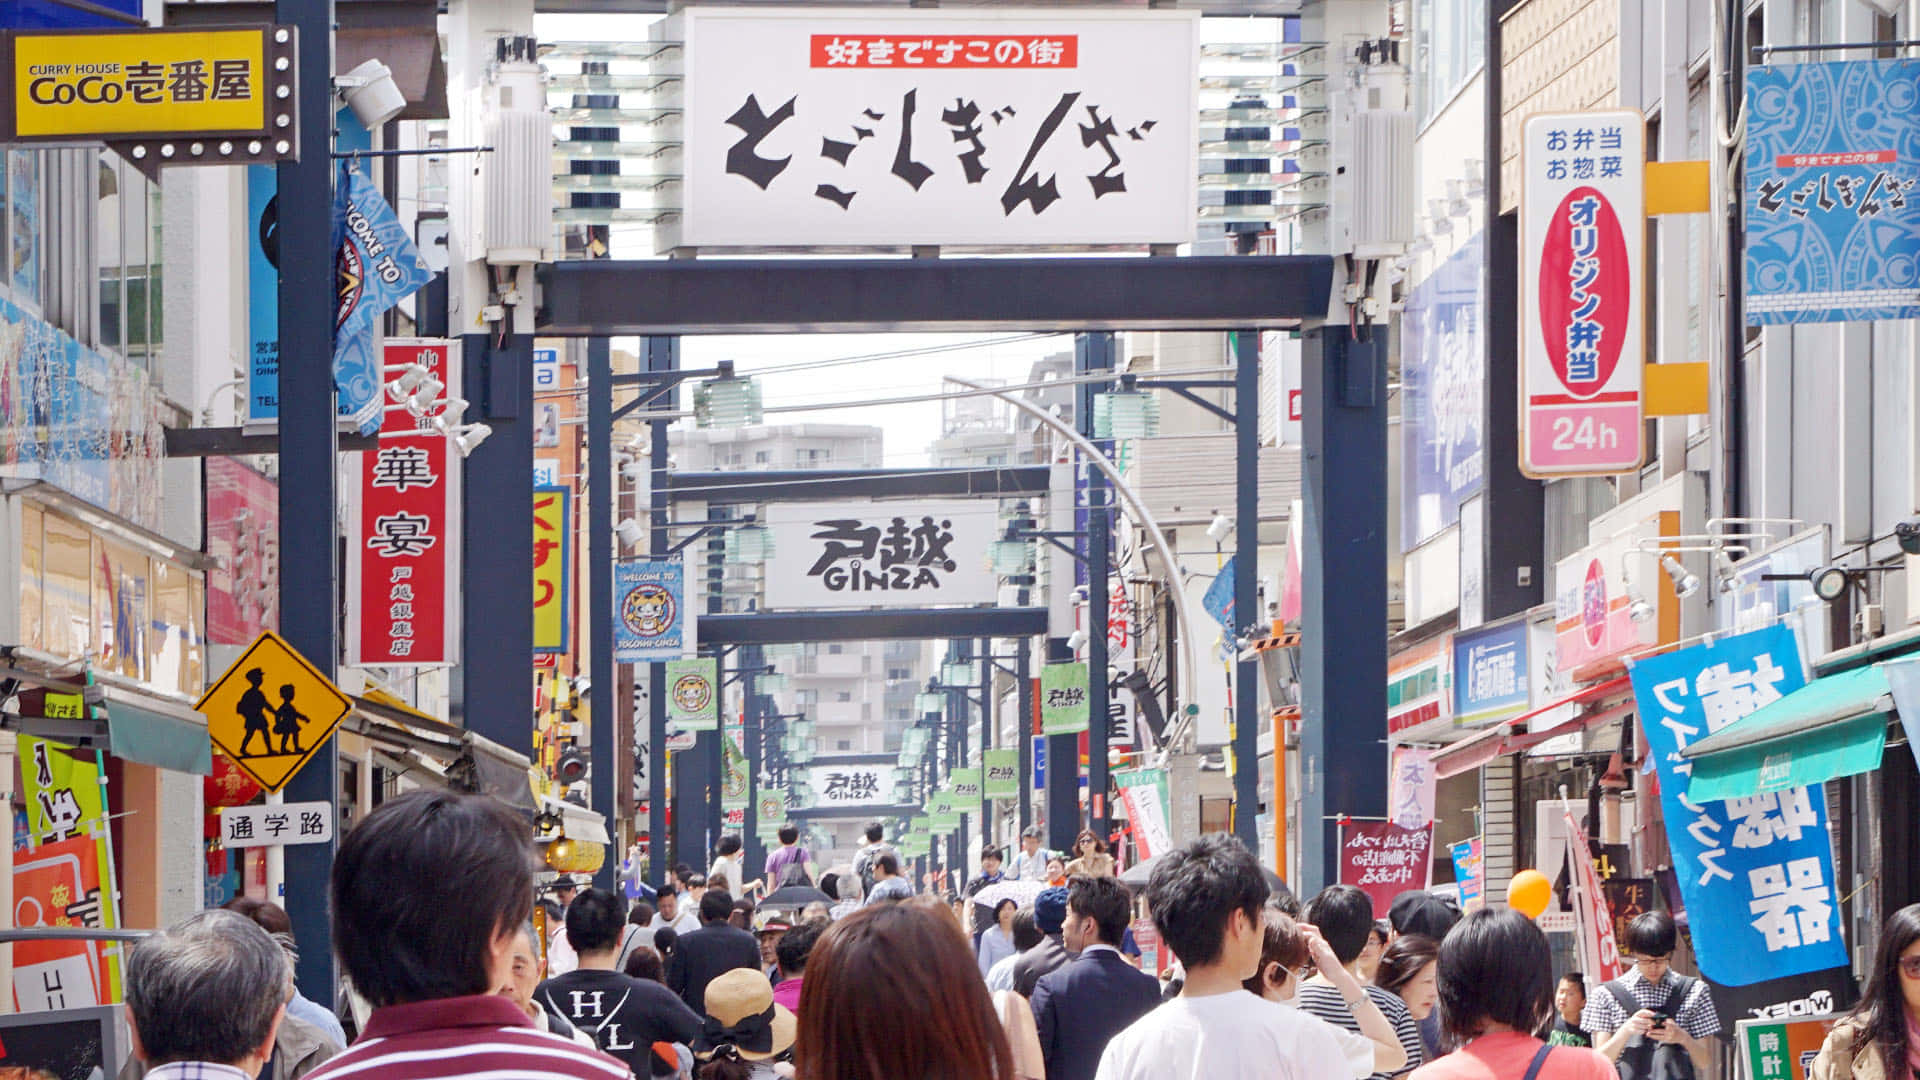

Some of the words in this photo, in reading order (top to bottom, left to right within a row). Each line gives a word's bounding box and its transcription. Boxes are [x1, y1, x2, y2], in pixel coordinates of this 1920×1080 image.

[824, 37, 1064, 66] 好きですこの街
[29, 64, 72, 76] CURRY
[75, 63, 120, 75] HOUSE
[724, 87, 1159, 217] とごしぎんざ
[1546, 127, 1623, 151] お弁当
[1546, 156, 1623, 180] お惣菜
[1791, 153, 1880, 167] 好きですこの街
[1756, 171, 1917, 217] とごしぎんざ
[376, 254, 402, 286] TO
[1567, 197, 1602, 384] オリジン弁当
[257, 396, 278, 407] TEL
[1552, 416, 1618, 452] 24h
[368, 448, 438, 557] 華宴
[807, 516, 957, 576] 戸越
[823, 559, 940, 591] GINZA
[390, 567, 415, 656] 戸越銀座店
[824, 772, 879, 793] 戸越
[829, 791, 873, 800] GINZA
[229, 811, 325, 841] 通学路
[569, 991, 605, 1018] H
[607, 1024, 634, 1050] L
[1758, 1032, 1785, 1080] 時計
